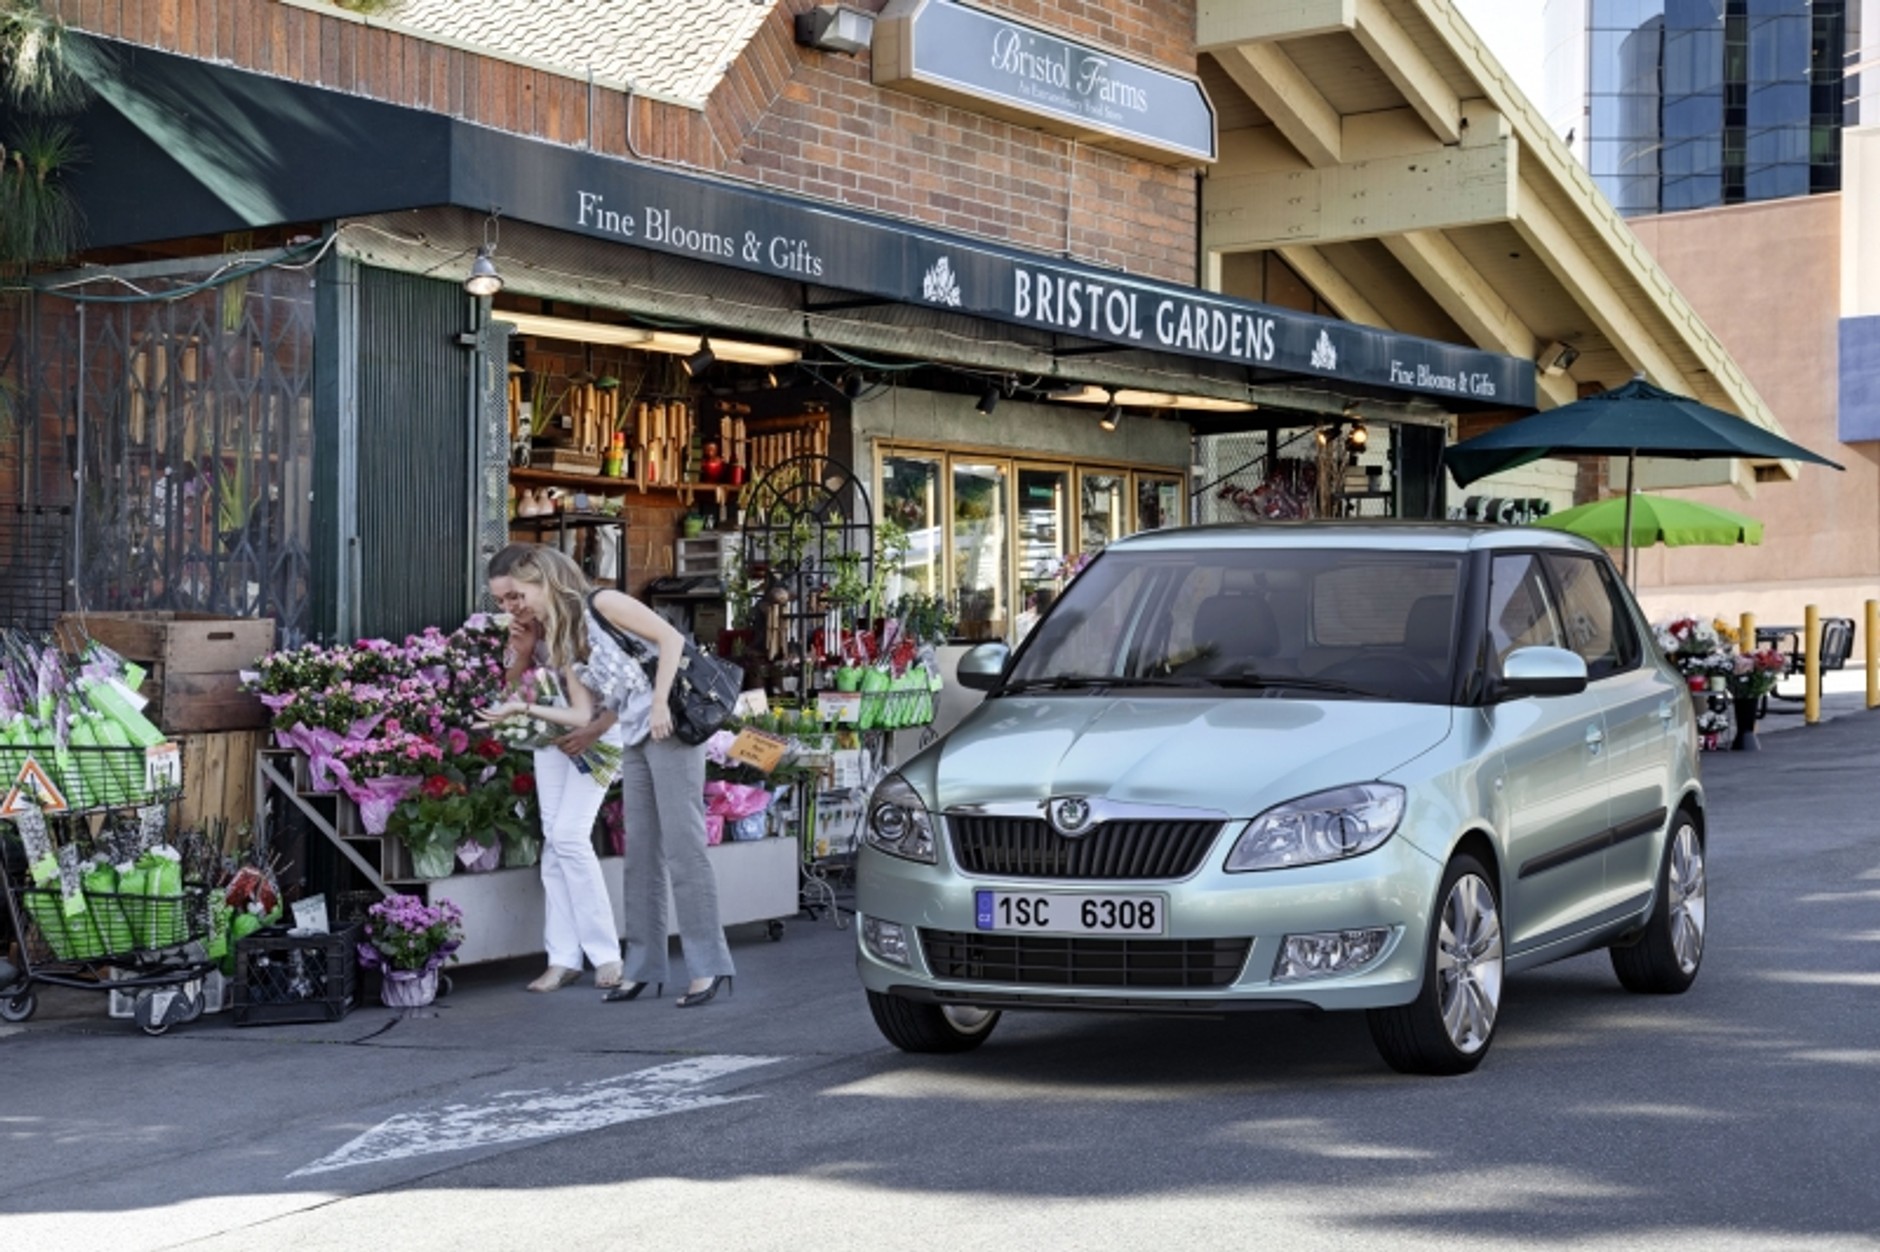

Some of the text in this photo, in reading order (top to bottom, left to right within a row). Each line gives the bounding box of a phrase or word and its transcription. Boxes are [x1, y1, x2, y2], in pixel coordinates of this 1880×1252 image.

[991, 28, 1148, 113] Bristol Farms
[577, 190, 823, 276] Fine Blooms & Gifts
[1014, 269, 1275, 361] BRISTOL GARDENS
[1390, 360, 1495, 396] Fine Blooms & Gifts
[1000, 897, 1155, 929] 1SC 6308
